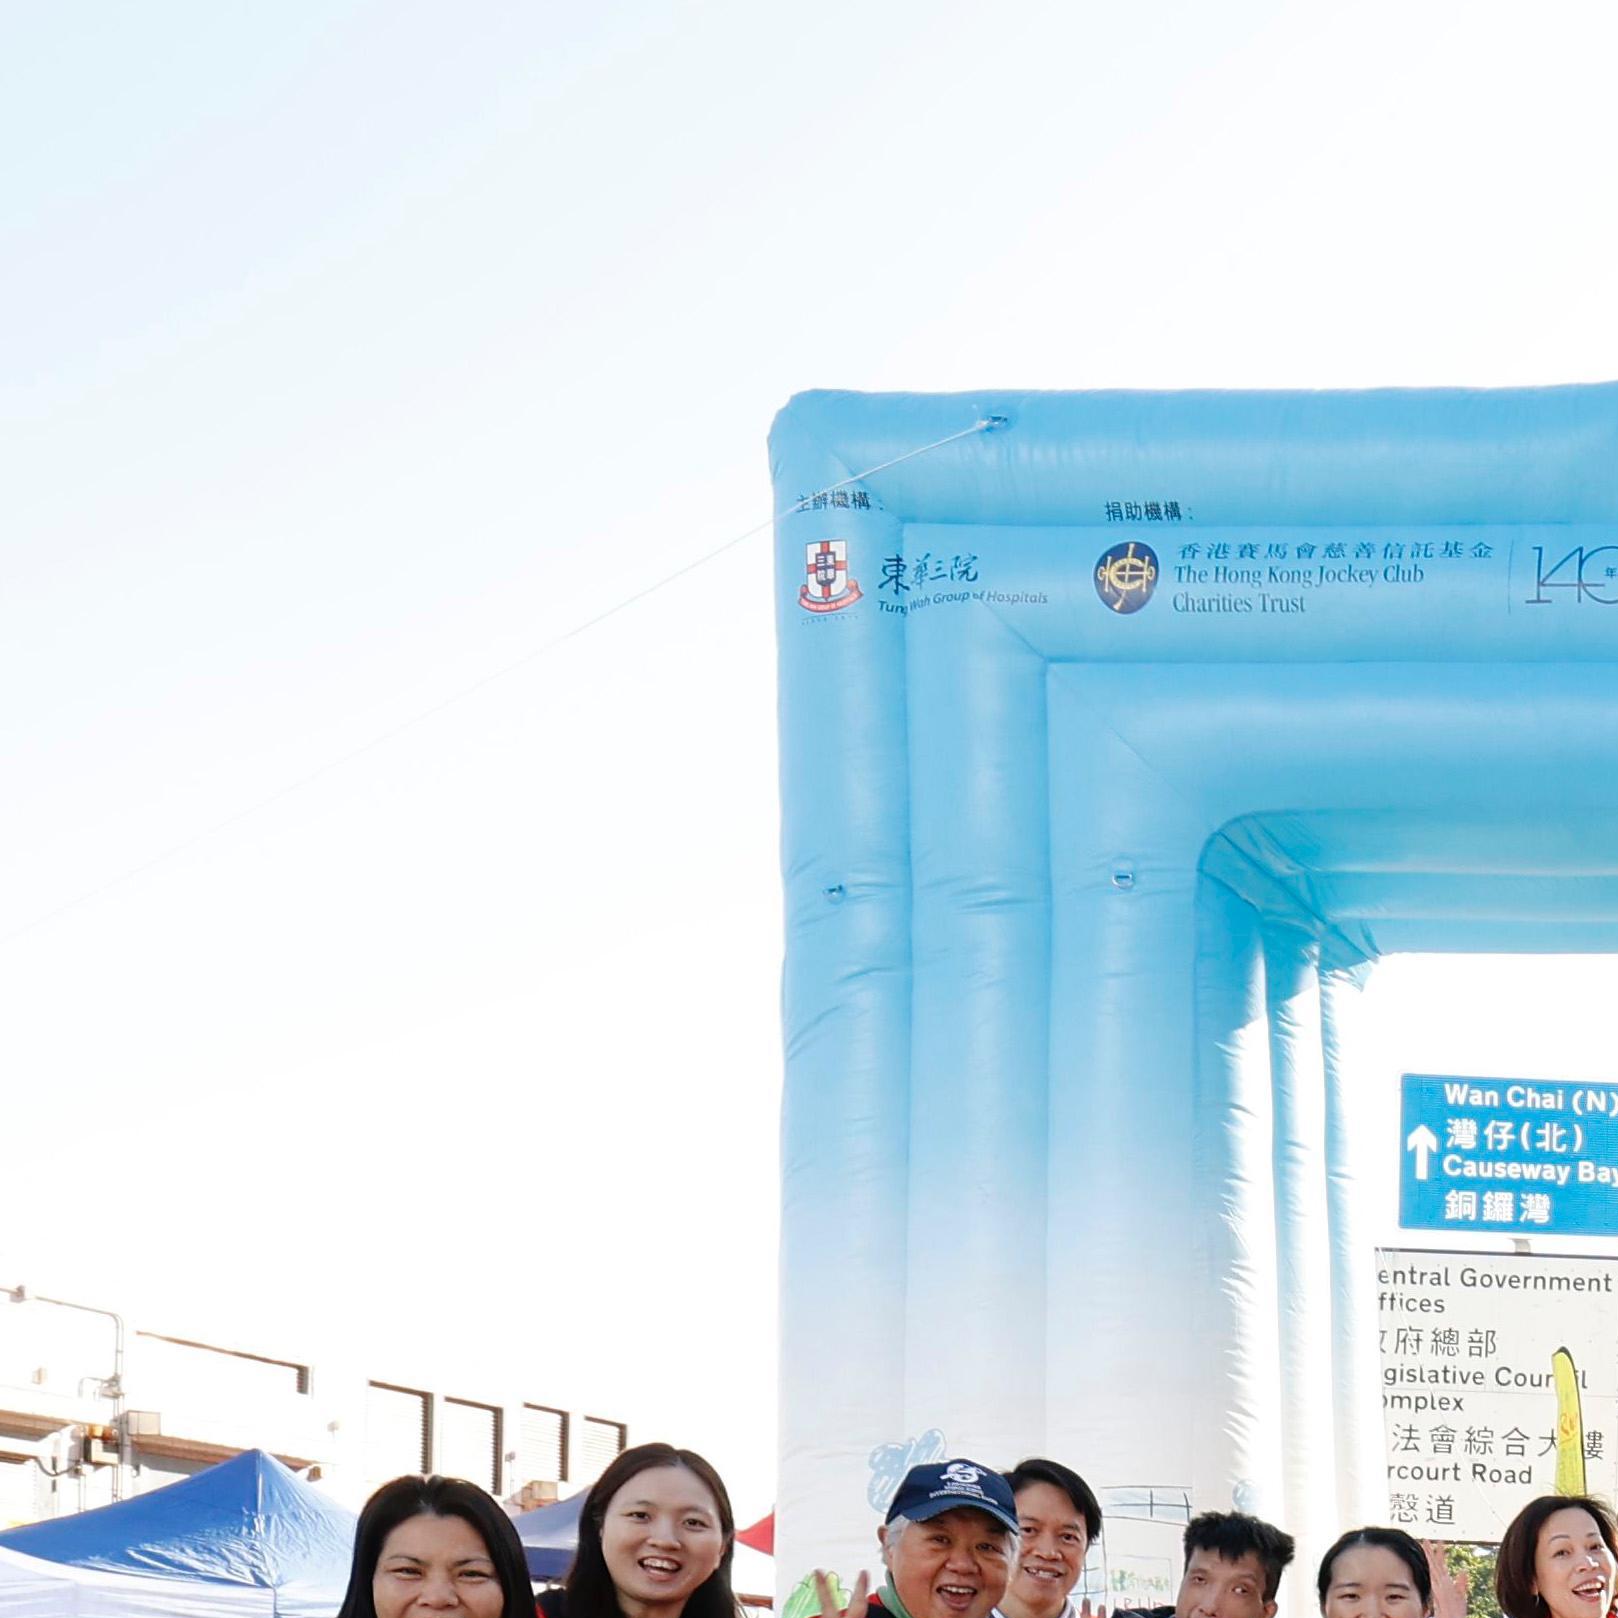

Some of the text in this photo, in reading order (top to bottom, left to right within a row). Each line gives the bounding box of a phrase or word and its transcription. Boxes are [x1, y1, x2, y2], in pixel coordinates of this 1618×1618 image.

[1179, 541, 1493, 560] 香港賽馬會慈善信託基金
[877, 551, 980, 597] 東華三院
[1175, 564, 1425, 589] The Hong Kong Jockey Club
[932, 590, 970, 609] Group
[987, 590, 1048, 605] Hospitals
[1173, 593, 1306, 613] Charities Trust
[1444, 1083, 1498, 1107] Wan
[1507, 1085, 1563, 1110] Chai
[1443, 1154, 1571, 1185] Causeway
[1445, 1189, 1551, 1224] 銅鑼灣
[1460, 1267, 1612, 1292] Government
[1495, 1366, 1588, 1389] Counl
[1472, 1463, 1532, 1484] Road
